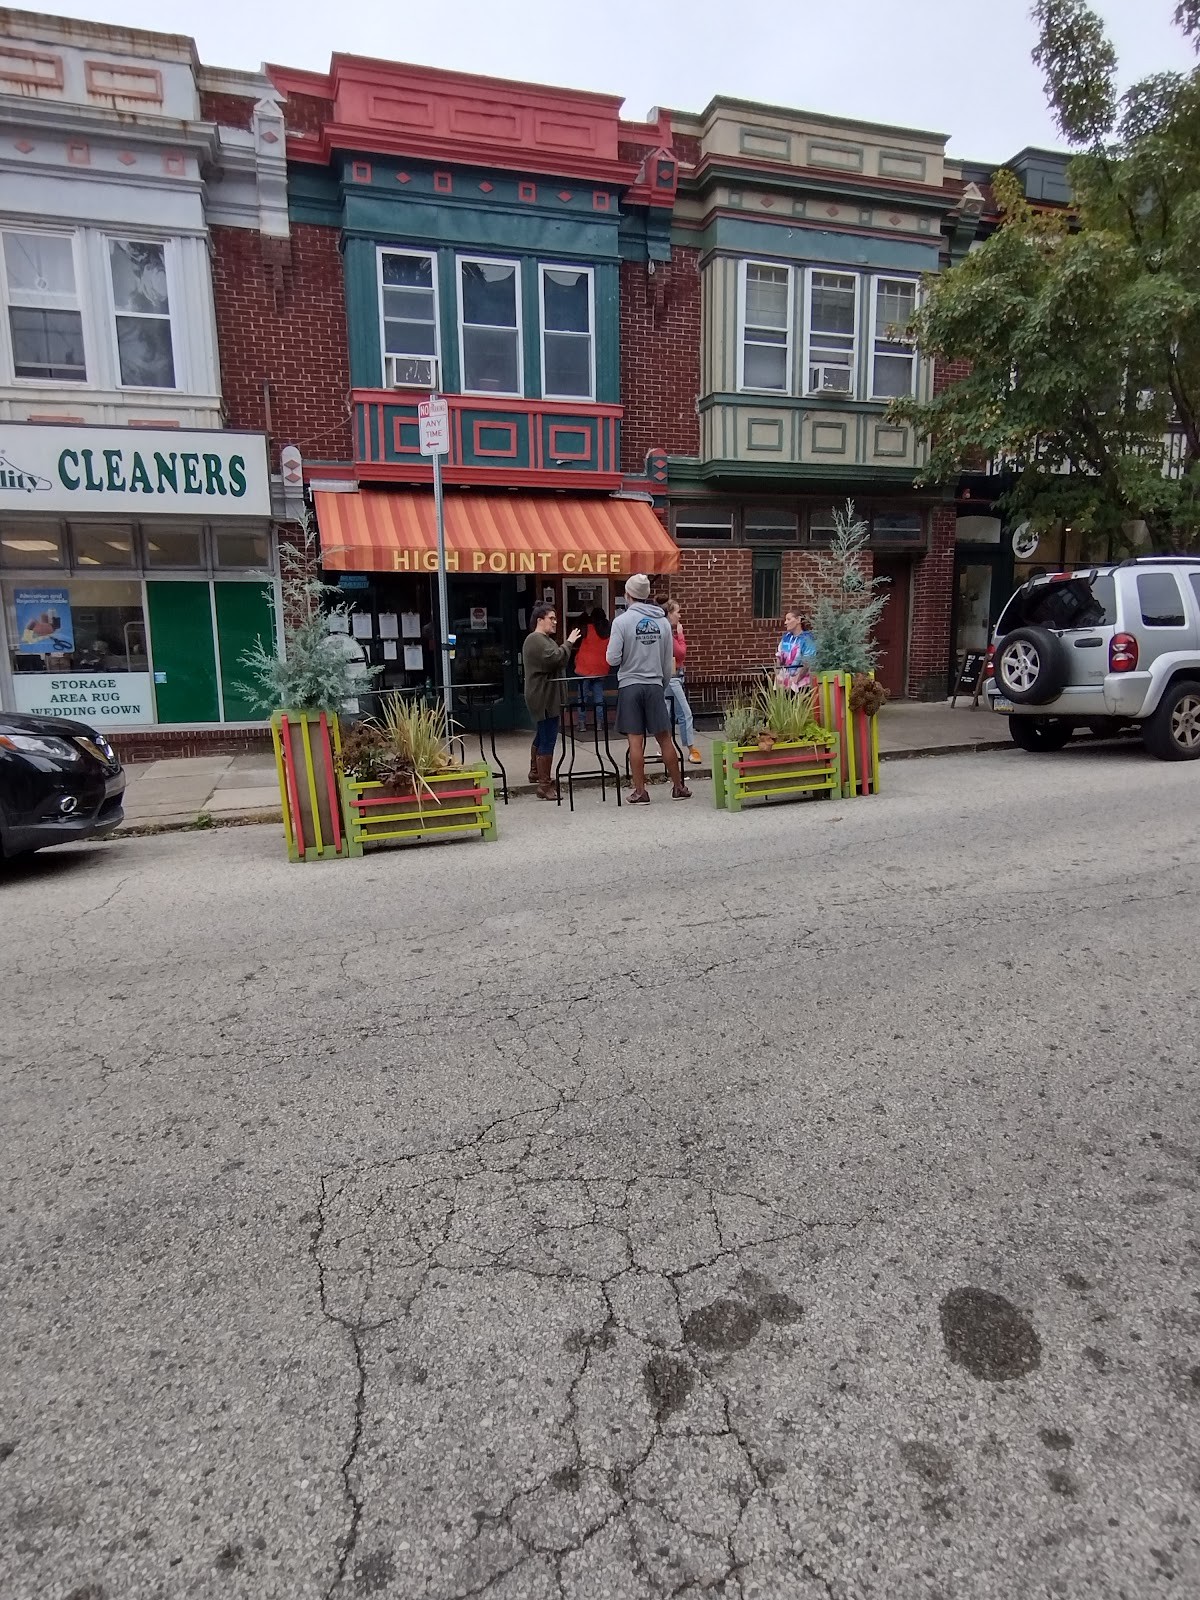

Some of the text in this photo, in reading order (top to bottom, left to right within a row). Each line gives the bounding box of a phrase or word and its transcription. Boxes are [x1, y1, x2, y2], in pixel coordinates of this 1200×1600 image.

[420, 405, 429, 416] NO
[426, 430, 443, 438] TIME
[58, 449, 247, 497] CLEANERS
[393, 550, 621, 573] HIGH POINT CAFE
[51, 680, 117, 689] STORAGE
[50, 692, 120, 703] AREA RUG
[31, 705, 141, 716] WEDDING GOWN
